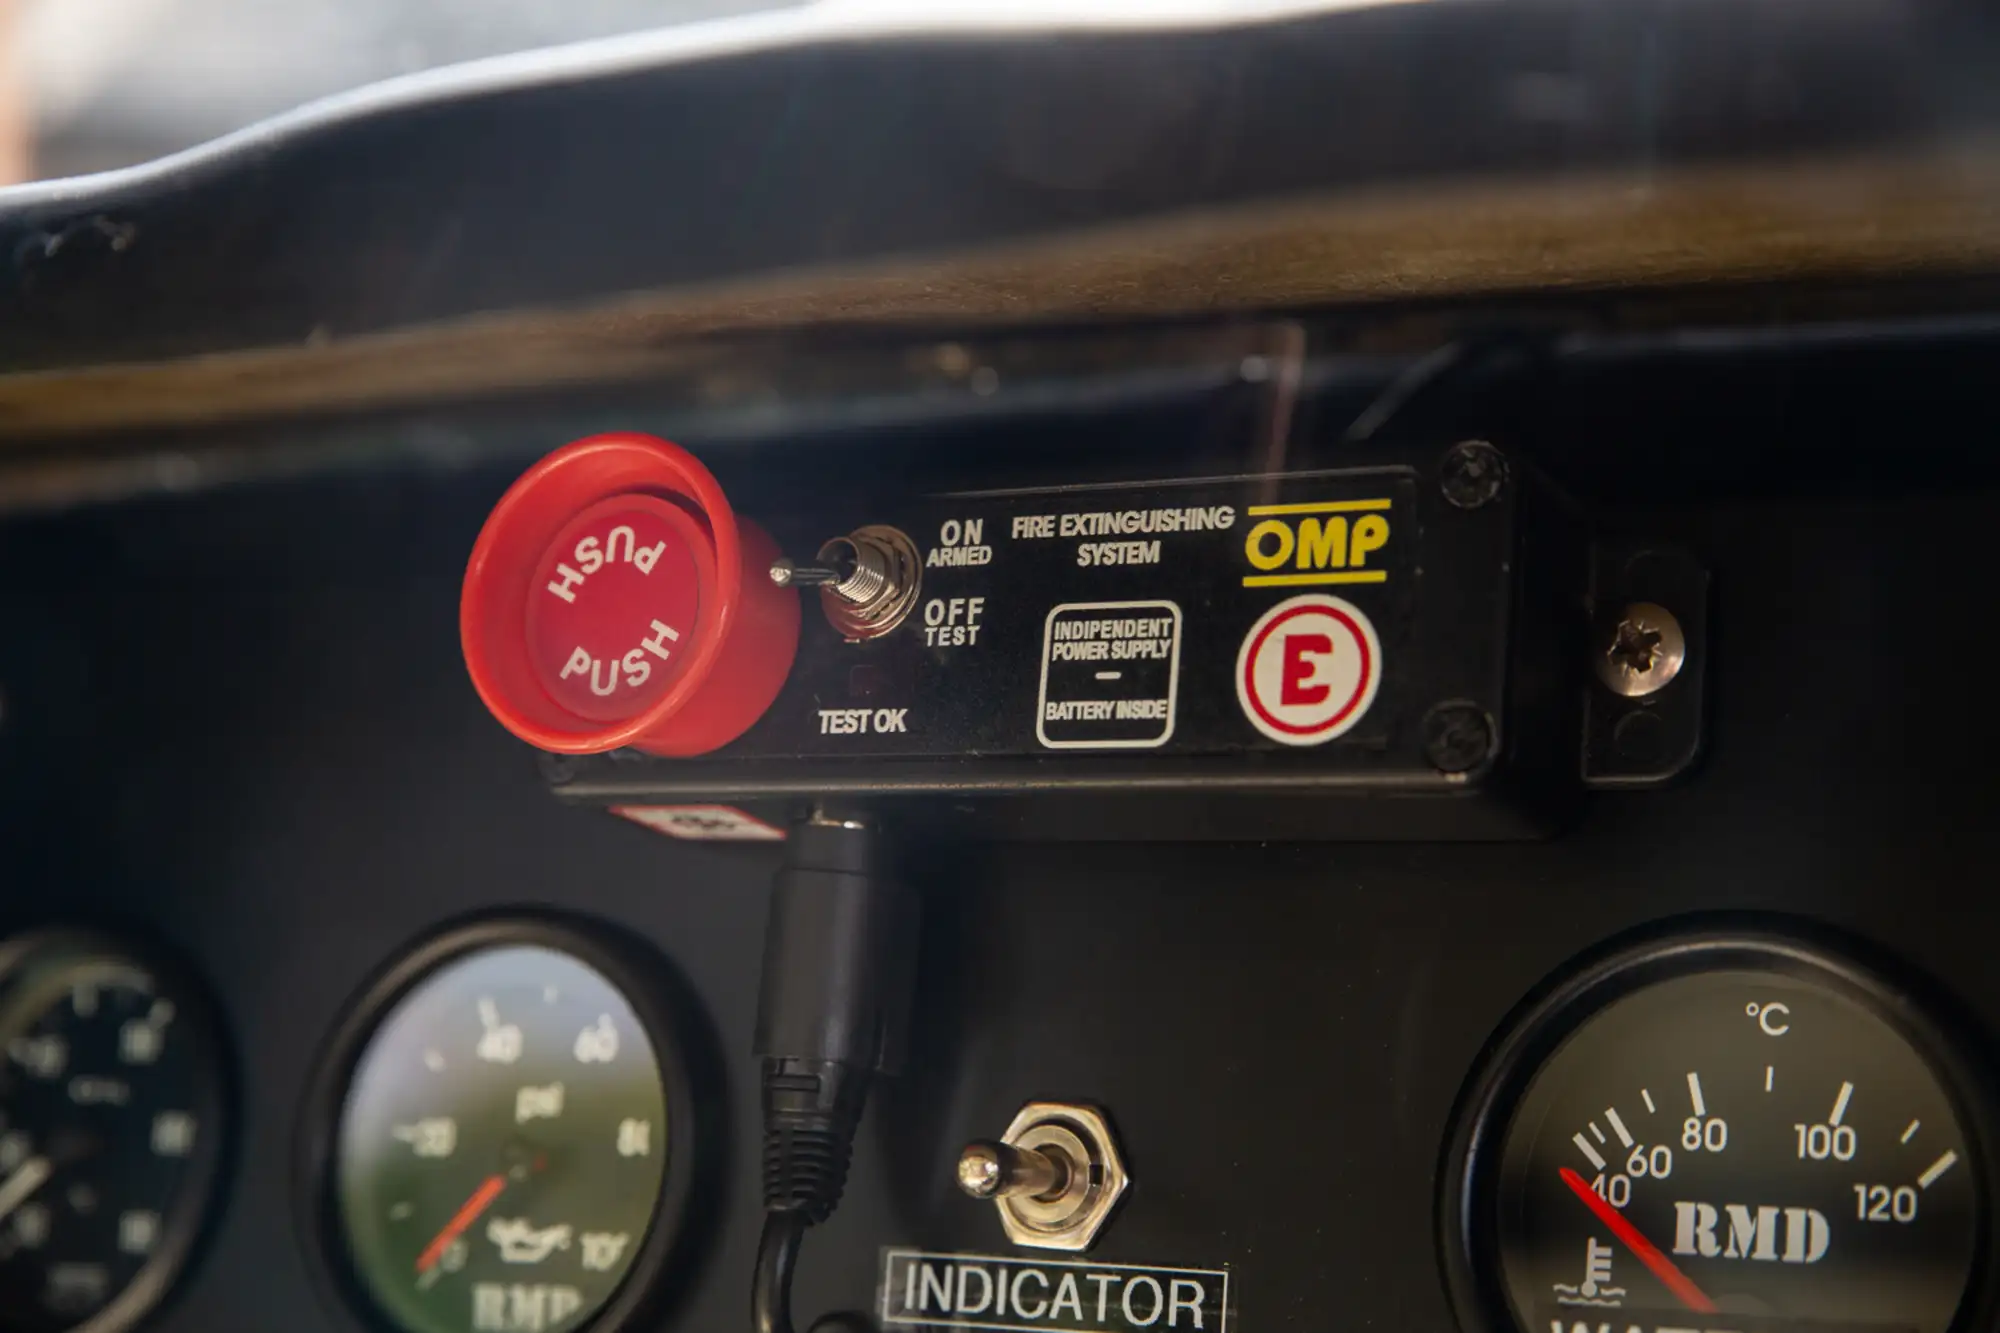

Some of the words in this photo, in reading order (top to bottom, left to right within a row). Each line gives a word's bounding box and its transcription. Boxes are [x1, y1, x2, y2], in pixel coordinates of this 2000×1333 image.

[940, 518, 984, 546] ON
[1011, 515, 1055, 539] FIRE
[1060, 506, 1236, 537] EXTINGUISHING
[926, 545, 993, 568] ARMED
[1077, 540, 1161, 567] SYSTEM
[1244, 514, 1390, 570] OMP
[548, 525, 667, 603] PUSH
[924, 597, 985, 626] OFF
[1053, 617, 1173, 641] INDIPENDENT
[924, 624, 981, 647] TEST
[1051, 640, 1109, 662] POWER
[1110, 638, 1172, 660] SUPPLY
[559, 619, 680, 697] PUSH
[1280, 634, 1334, 707] E
[817, 708, 873, 735] TEST
[873, 708, 908, 734] OK
[1045, 700, 1116, 721] BATTERY
[1115, 699, 1168, 720] INSIDE
[1745, 1001, 1790, 1037] °C
[1681, 1116, 1728, 1153] 80
[1793, 1123, 1857, 1161] 100
[1625, 1143, 1673, 1180] 60
[1852, 1183, 1918, 1222] 120
[1672, 1200, 1831, 1264] RMD
[904, 1261, 1206, 1330] INDICATOR
